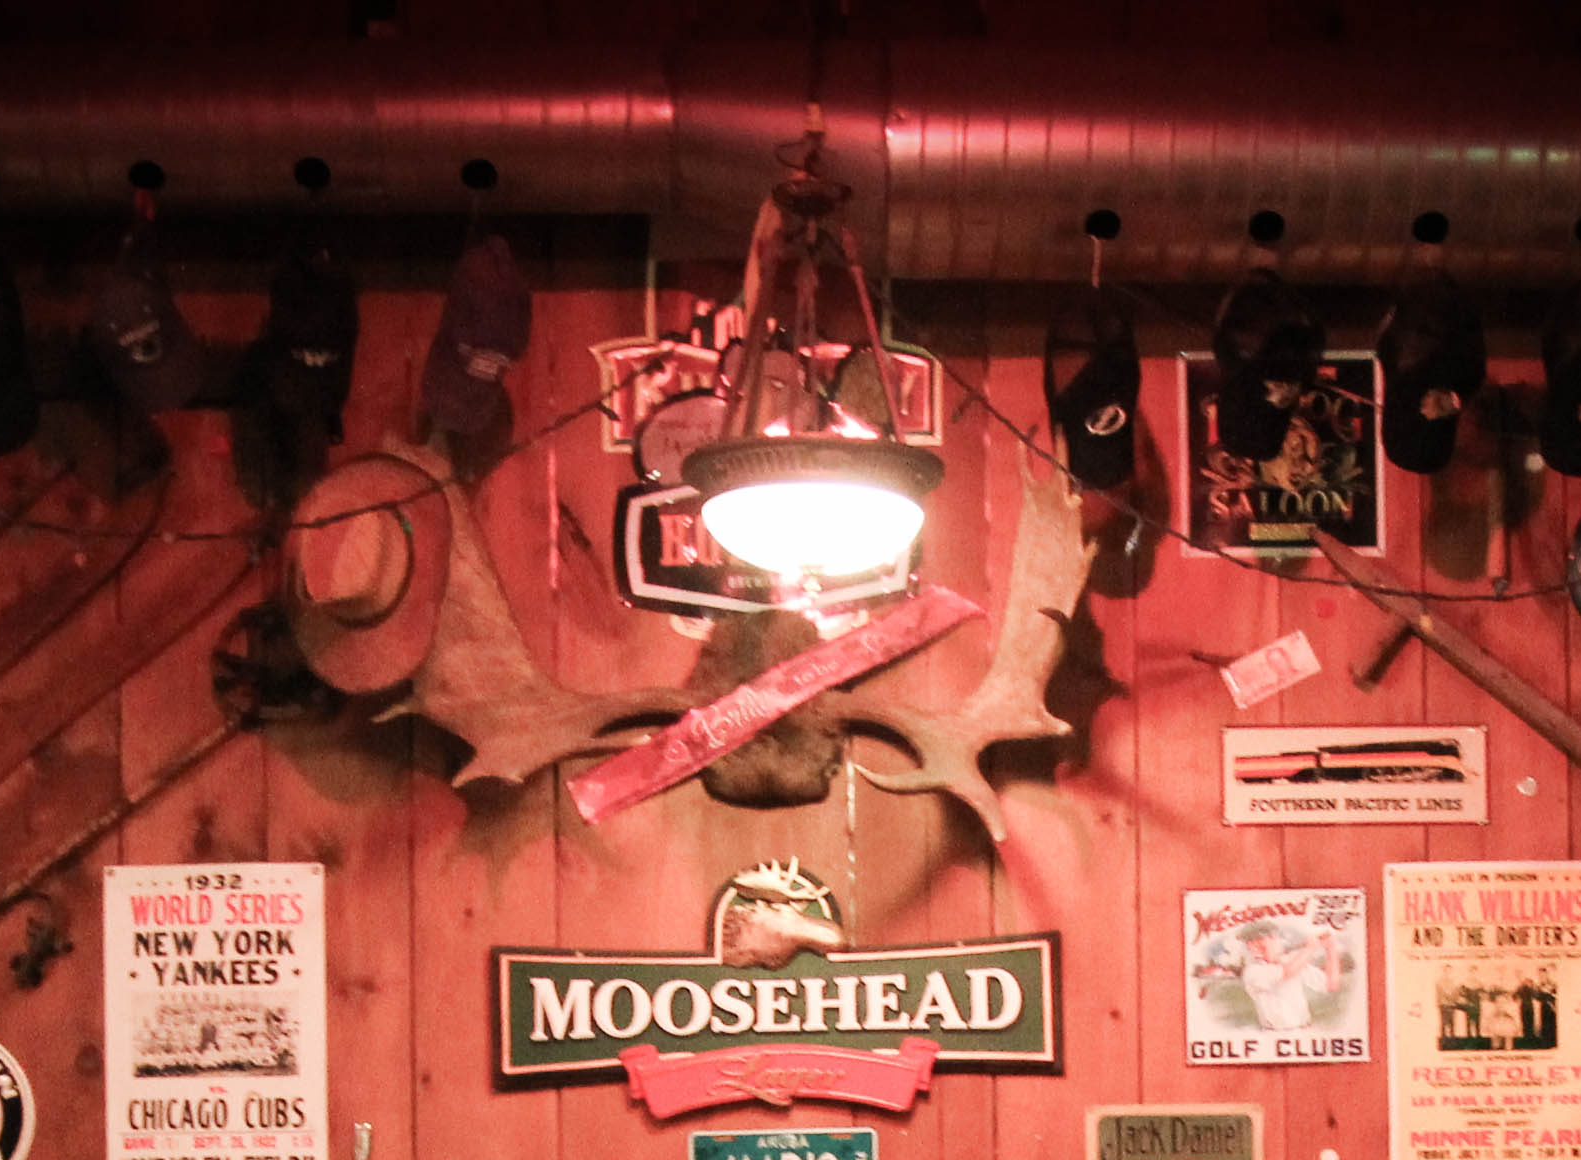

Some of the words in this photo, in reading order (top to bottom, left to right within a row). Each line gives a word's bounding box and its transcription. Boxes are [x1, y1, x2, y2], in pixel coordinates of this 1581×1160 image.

[1209, 489, 1353, 518] SALOON
[1249, 798, 1337, 812] SOUTHERN
[1345, 798, 1410, 811] PACIFIC
[1416, 797, 1464, 811] LINES
[186, 874, 243, 891] 1932
[131, 894, 213, 926] WORLD
[225, 893, 305, 925] SERIES
[1404, 889, 1468, 923] HANK
[134, 930, 197, 957] NEW
[213, 929, 295, 955] YORK
[1413, 926, 1444, 947] AND
[1455, 926, 1484, 947] THE
[152, 960, 280, 987] YANKEES
[528, 966, 1023, 1042] MOOSEHEAD
[1191, 1040, 1259, 1059] GOLF
[1276, 1038, 1363, 1058] CLUBS
[1412, 1065, 1475, 1083] RED
[129, 1098, 229, 1130] CHICAGO
[245, 1097, 306, 1129] CUBS
[1410, 1130, 1496, 1148] MINNIE
